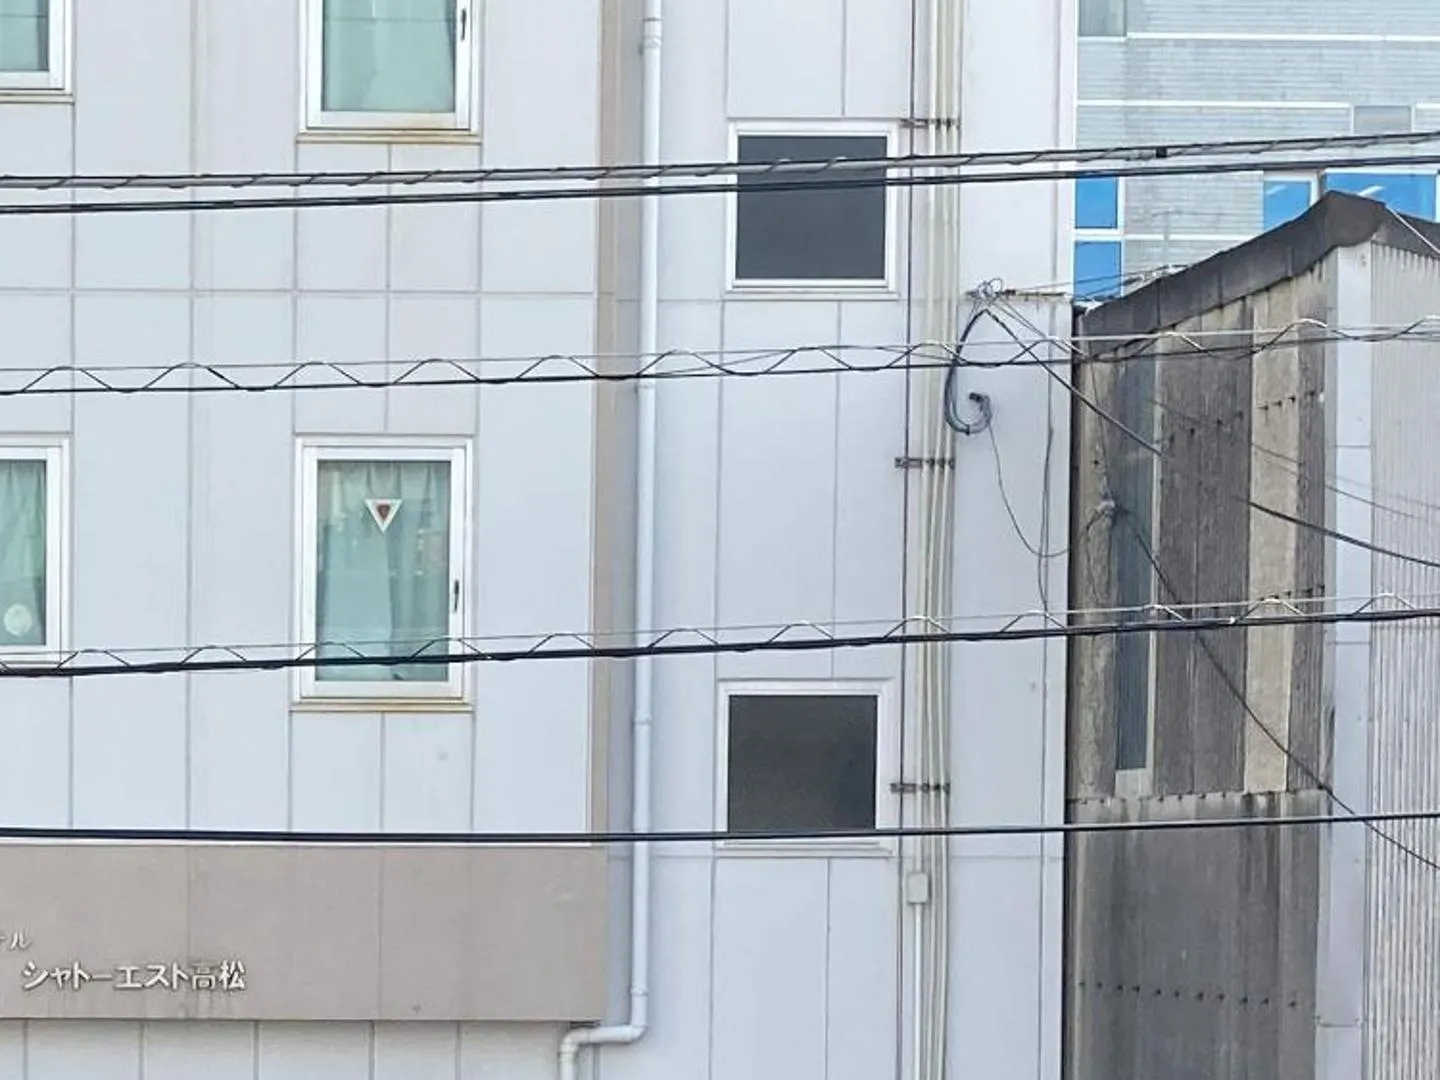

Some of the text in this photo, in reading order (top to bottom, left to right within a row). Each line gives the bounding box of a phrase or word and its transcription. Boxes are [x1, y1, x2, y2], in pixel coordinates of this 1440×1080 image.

[21, 959, 247, 992] シャトーエスト高松
